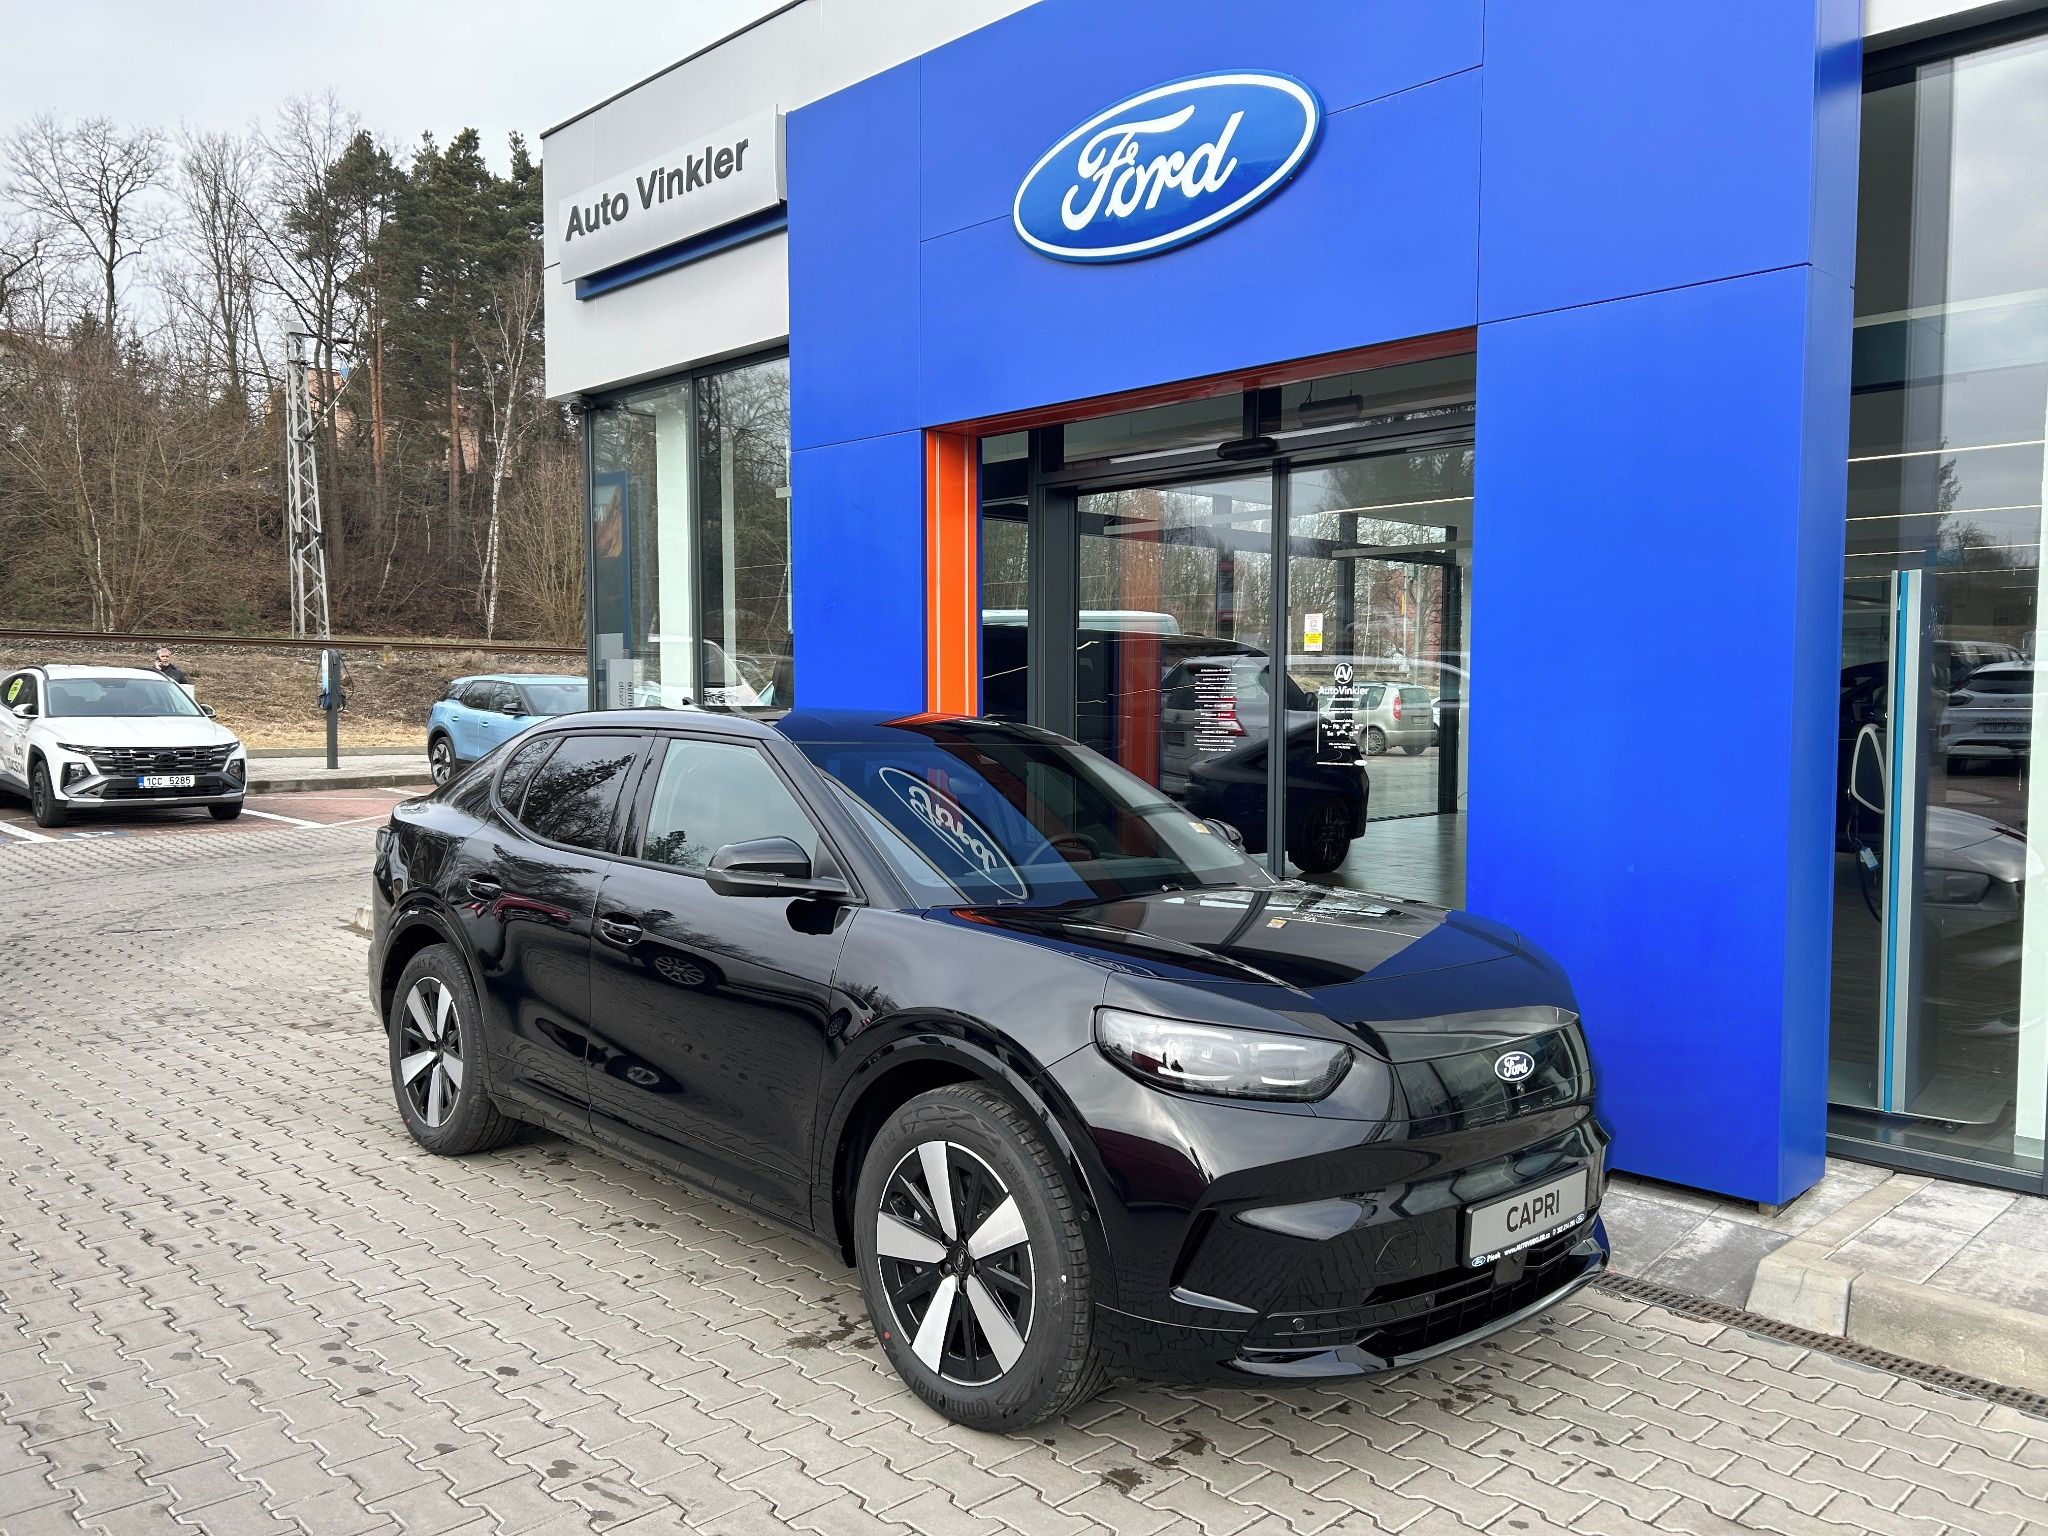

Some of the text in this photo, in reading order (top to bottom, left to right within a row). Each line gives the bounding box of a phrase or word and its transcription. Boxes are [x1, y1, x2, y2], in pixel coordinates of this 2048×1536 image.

[1061, 104, 1244, 231] Ford
[565, 138, 749, 242] Auto Vinkler
[1318, 685, 1370, 695] AutoVinkler
[146, 776, 191, 785] 1CC 5285
[1503, 1055, 1529, 1078] Ford
[1506, 1189, 1560, 1233] CAPRI
